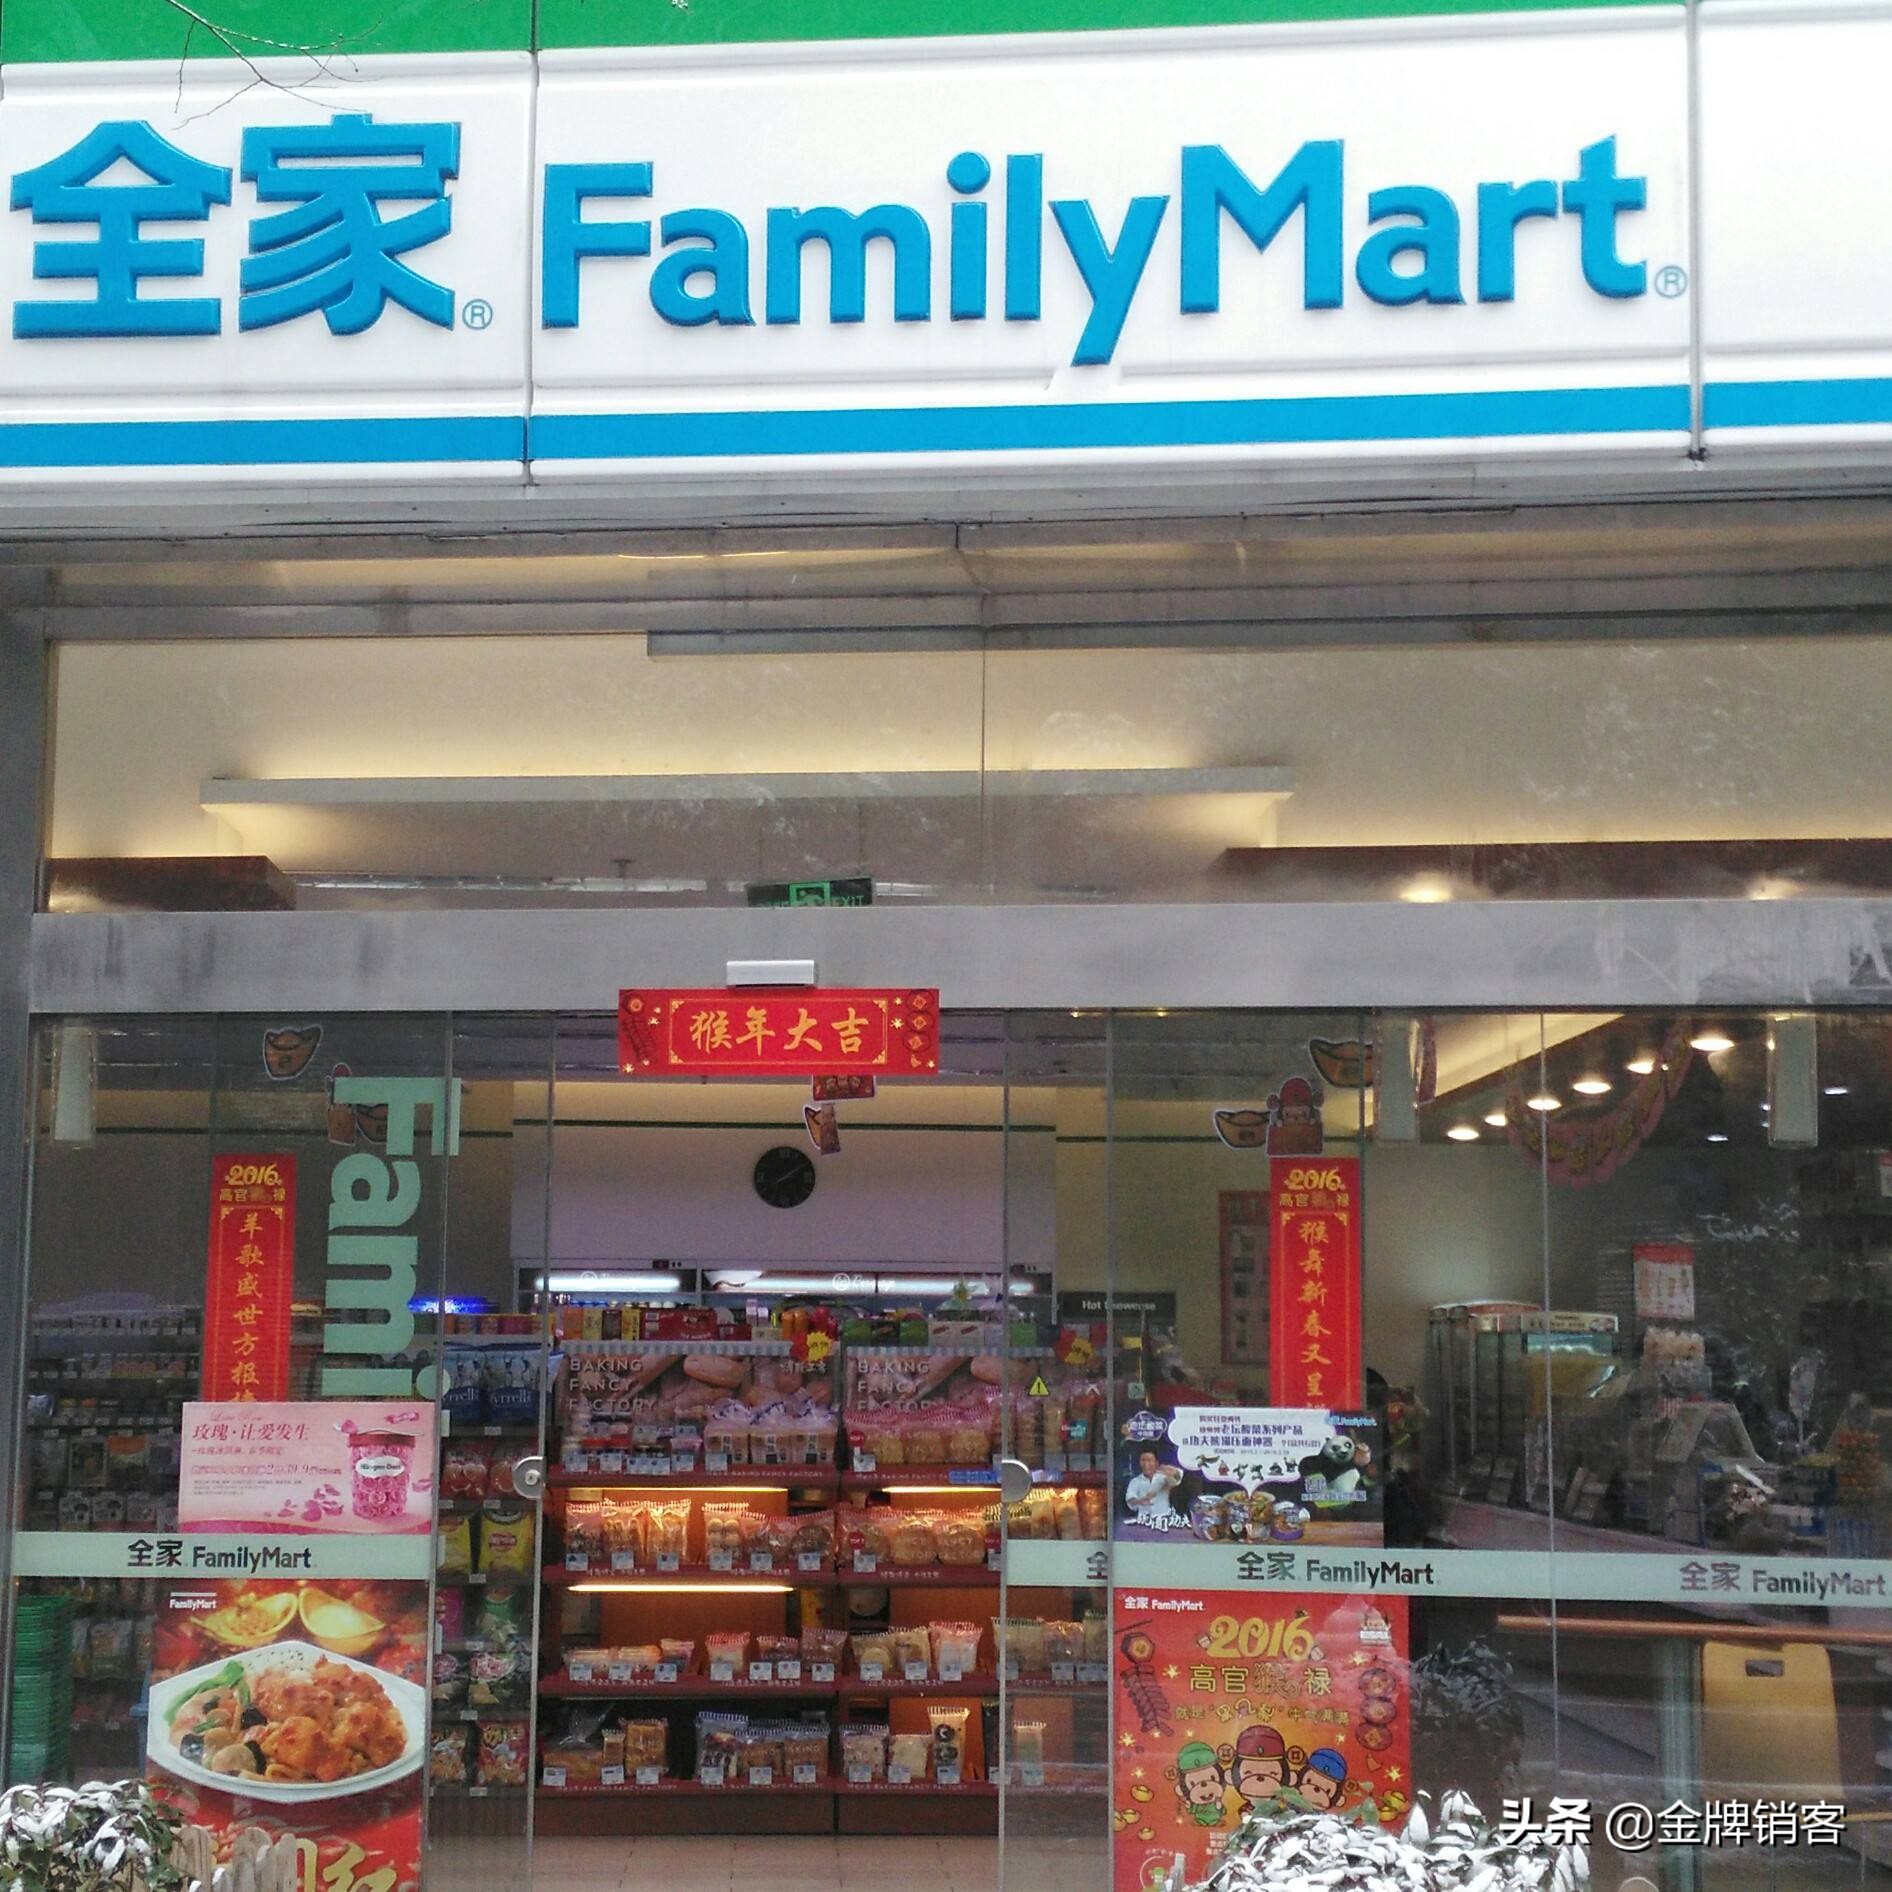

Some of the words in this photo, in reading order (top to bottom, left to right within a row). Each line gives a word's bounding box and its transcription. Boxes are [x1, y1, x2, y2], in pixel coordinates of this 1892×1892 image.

[11, 113, 461, 340] 全家
[542, 135, 1646, 366] FamilyMart
[689, 1006, 869, 1056] 猴年大吉
[228, 1163, 279, 1186] 2016
[1288, 1167, 1341, 1190] 2016
[1082, 1300, 1101, 1310] Hot
[1298, 1221, 1331, 1408] 猴舞新春又呈
[569, 1359, 643, 1372] BAKING
[857, 1359, 930, 1374] BAKING
[569, 1379, 634, 1391] FANCY
[857, 1380, 919, 1394] FANCY
[127, 1539, 183, 1567] 全家
[193, 1546, 312, 1573] FamilyMart
[1236, 1551, 1296, 1581] 全家
[1306, 1559, 1434, 1588] FamilyMart
[1679, 1561, 1741, 1591] 全家
[1752, 1569, 1886, 1600] FamilyMart
[169, 1599, 217, 1611] FamilyMart
[1124, 1597, 1149, 1609] 全家
[1152, 1600, 1203, 1612] FamilyMart
[1206, 1615, 1314, 1662] 2016
